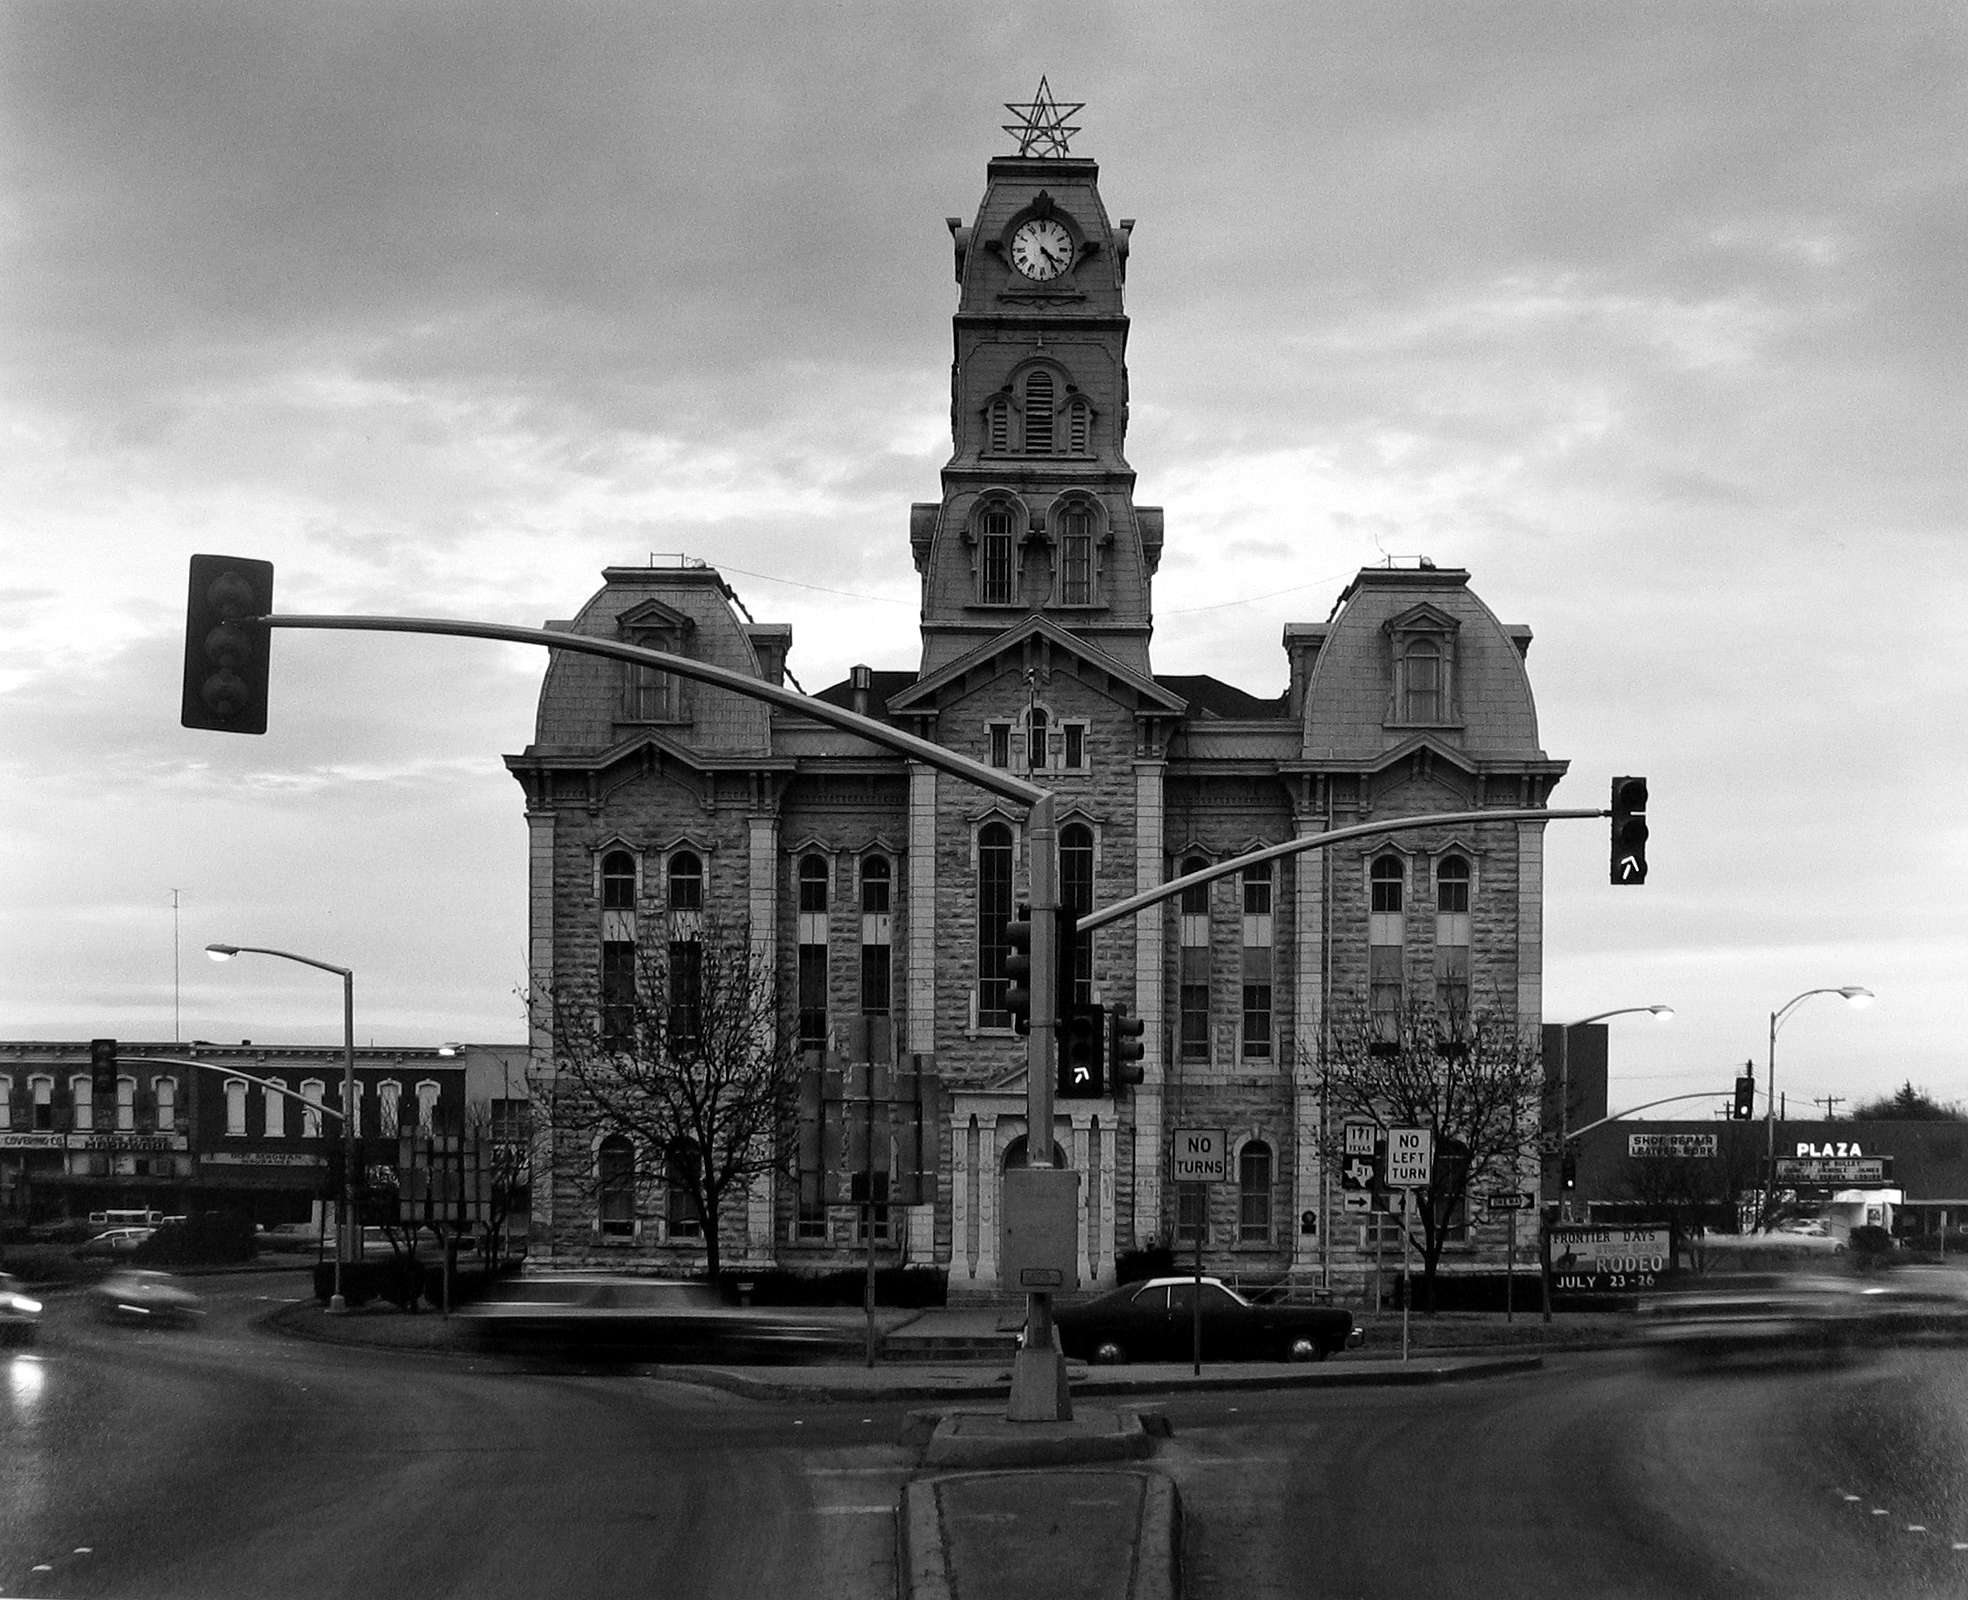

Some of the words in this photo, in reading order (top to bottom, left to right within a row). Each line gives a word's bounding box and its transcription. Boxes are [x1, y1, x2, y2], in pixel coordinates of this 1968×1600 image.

[1352, 1129, 1370, 1140] 171
[1188, 1137, 1211, 1153] NO
[1399, 1136, 1419, 1148] NO
[1797, 1141, 1862, 1158] PLAZA
[1393, 1153, 1425, 1164] LEFT
[1177, 1160, 1223, 1174] TURNS
[1357, 1166, 1368, 1177] 51
[1392, 1168, 1426, 1179] TURN
[1553, 1232, 1611, 1244] FRONTIER
[1623, 1231, 1656, 1242] DAYS
[1596, 1255, 1663, 1273] RODEO
[1556, 1276, 1597, 1288] JULY
